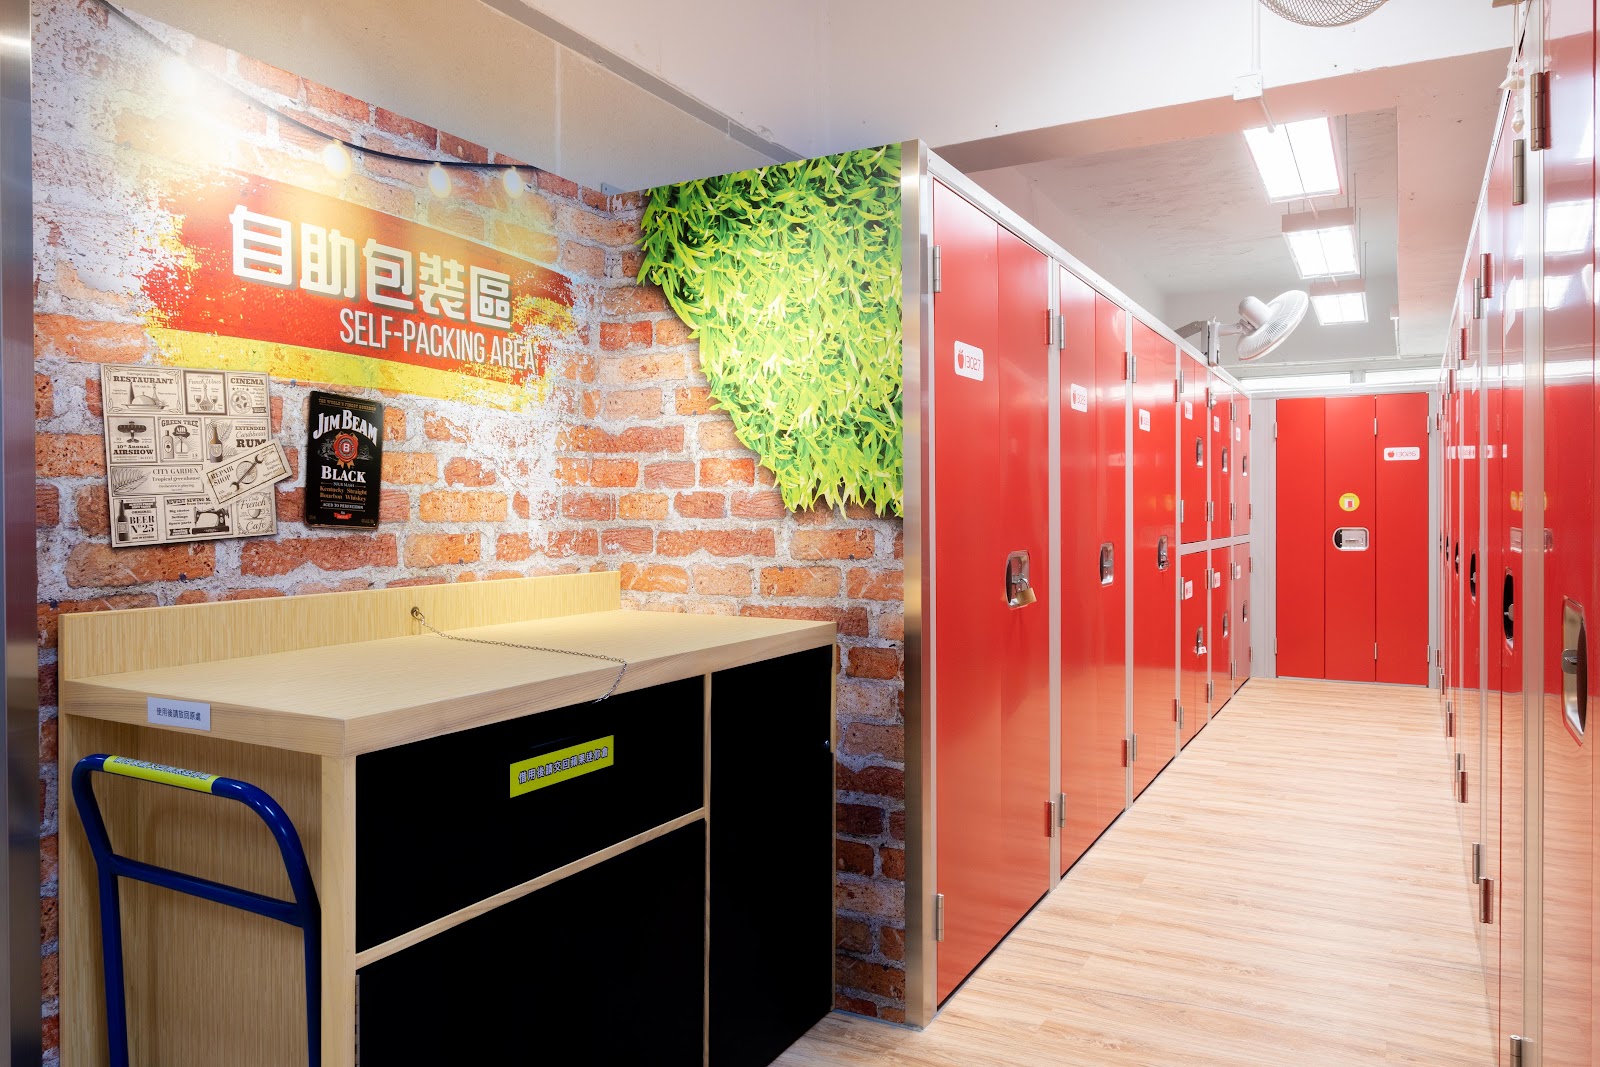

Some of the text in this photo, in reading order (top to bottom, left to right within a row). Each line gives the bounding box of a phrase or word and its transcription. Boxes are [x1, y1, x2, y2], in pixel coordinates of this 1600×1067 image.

[229, 204, 511, 330] 自助包裝區
[340, 308, 537, 371] SELF-PACKING AREA
[964, 354, 981, 372] 13027
[113, 375, 174, 385] RESTAURANT
[161, 419, 199, 428] GREEN TREE
[313, 409, 378, 447] JIM BEAM
[236, 439, 267, 448] RUM
[170, 467, 199, 475] GARDEN
[211, 465, 234, 480] REPAIR
[321, 465, 366, 483] BLACK
[213, 474, 231, 487] SHOP
[129, 515, 155, 524] BEER
